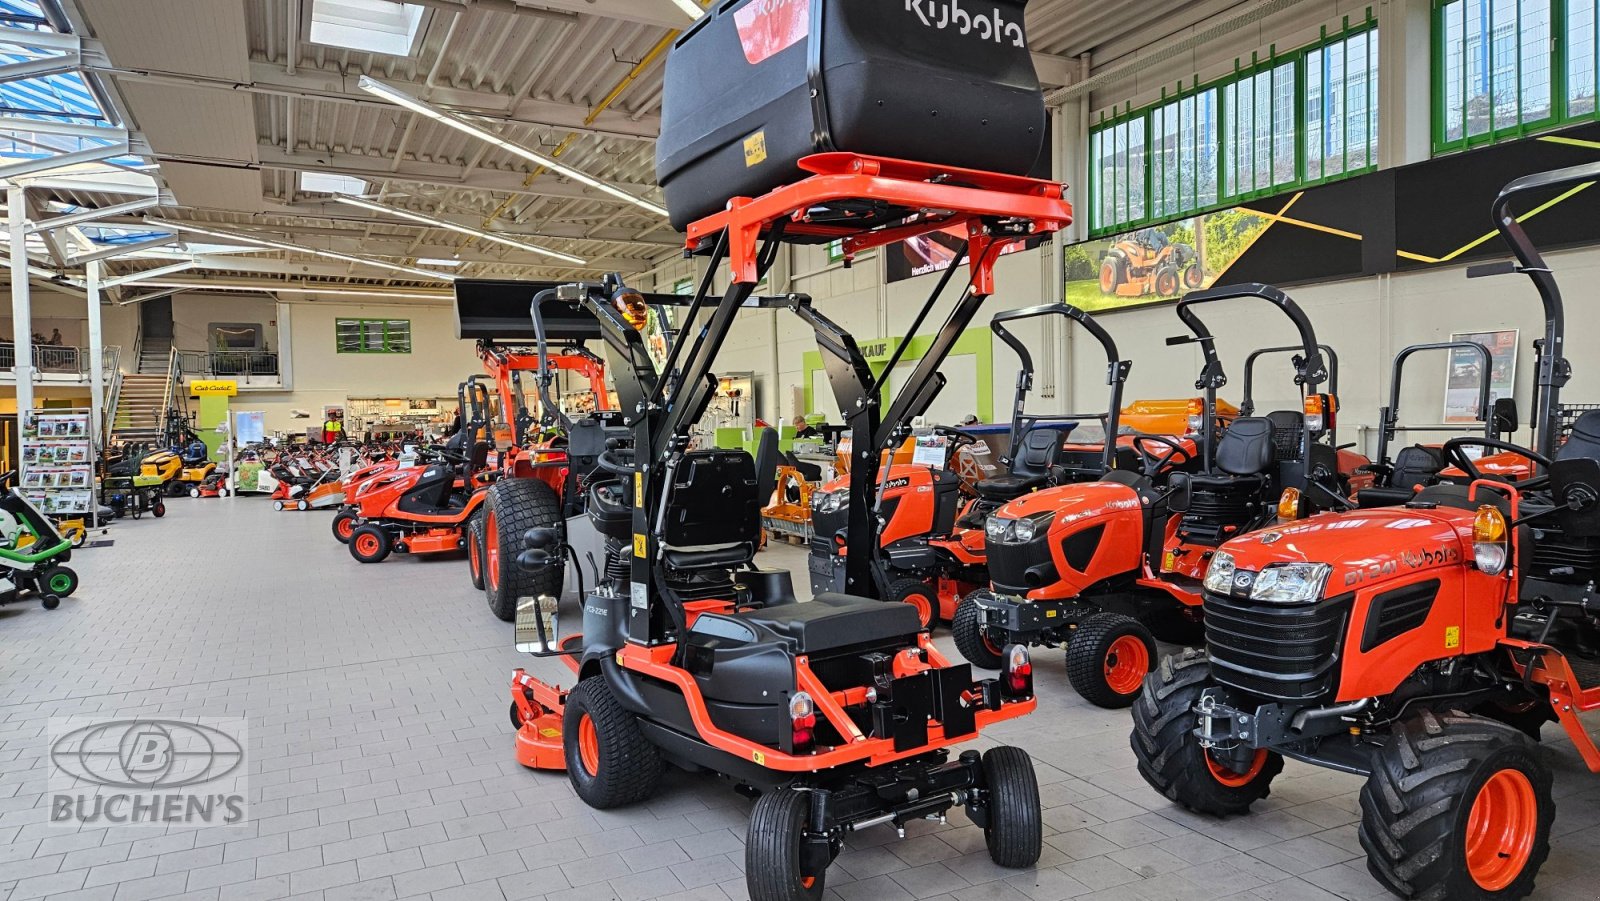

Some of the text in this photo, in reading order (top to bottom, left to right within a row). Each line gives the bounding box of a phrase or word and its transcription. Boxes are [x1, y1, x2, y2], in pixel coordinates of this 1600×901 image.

[905, 0, 1024, 48] Kubota
[911, 263, 934, 277] Herzlich
[859, 343, 887, 358] KAUF
[884, 478, 907, 489] ubota
[1345, 545, 1457, 586] B1-241 Kubota
